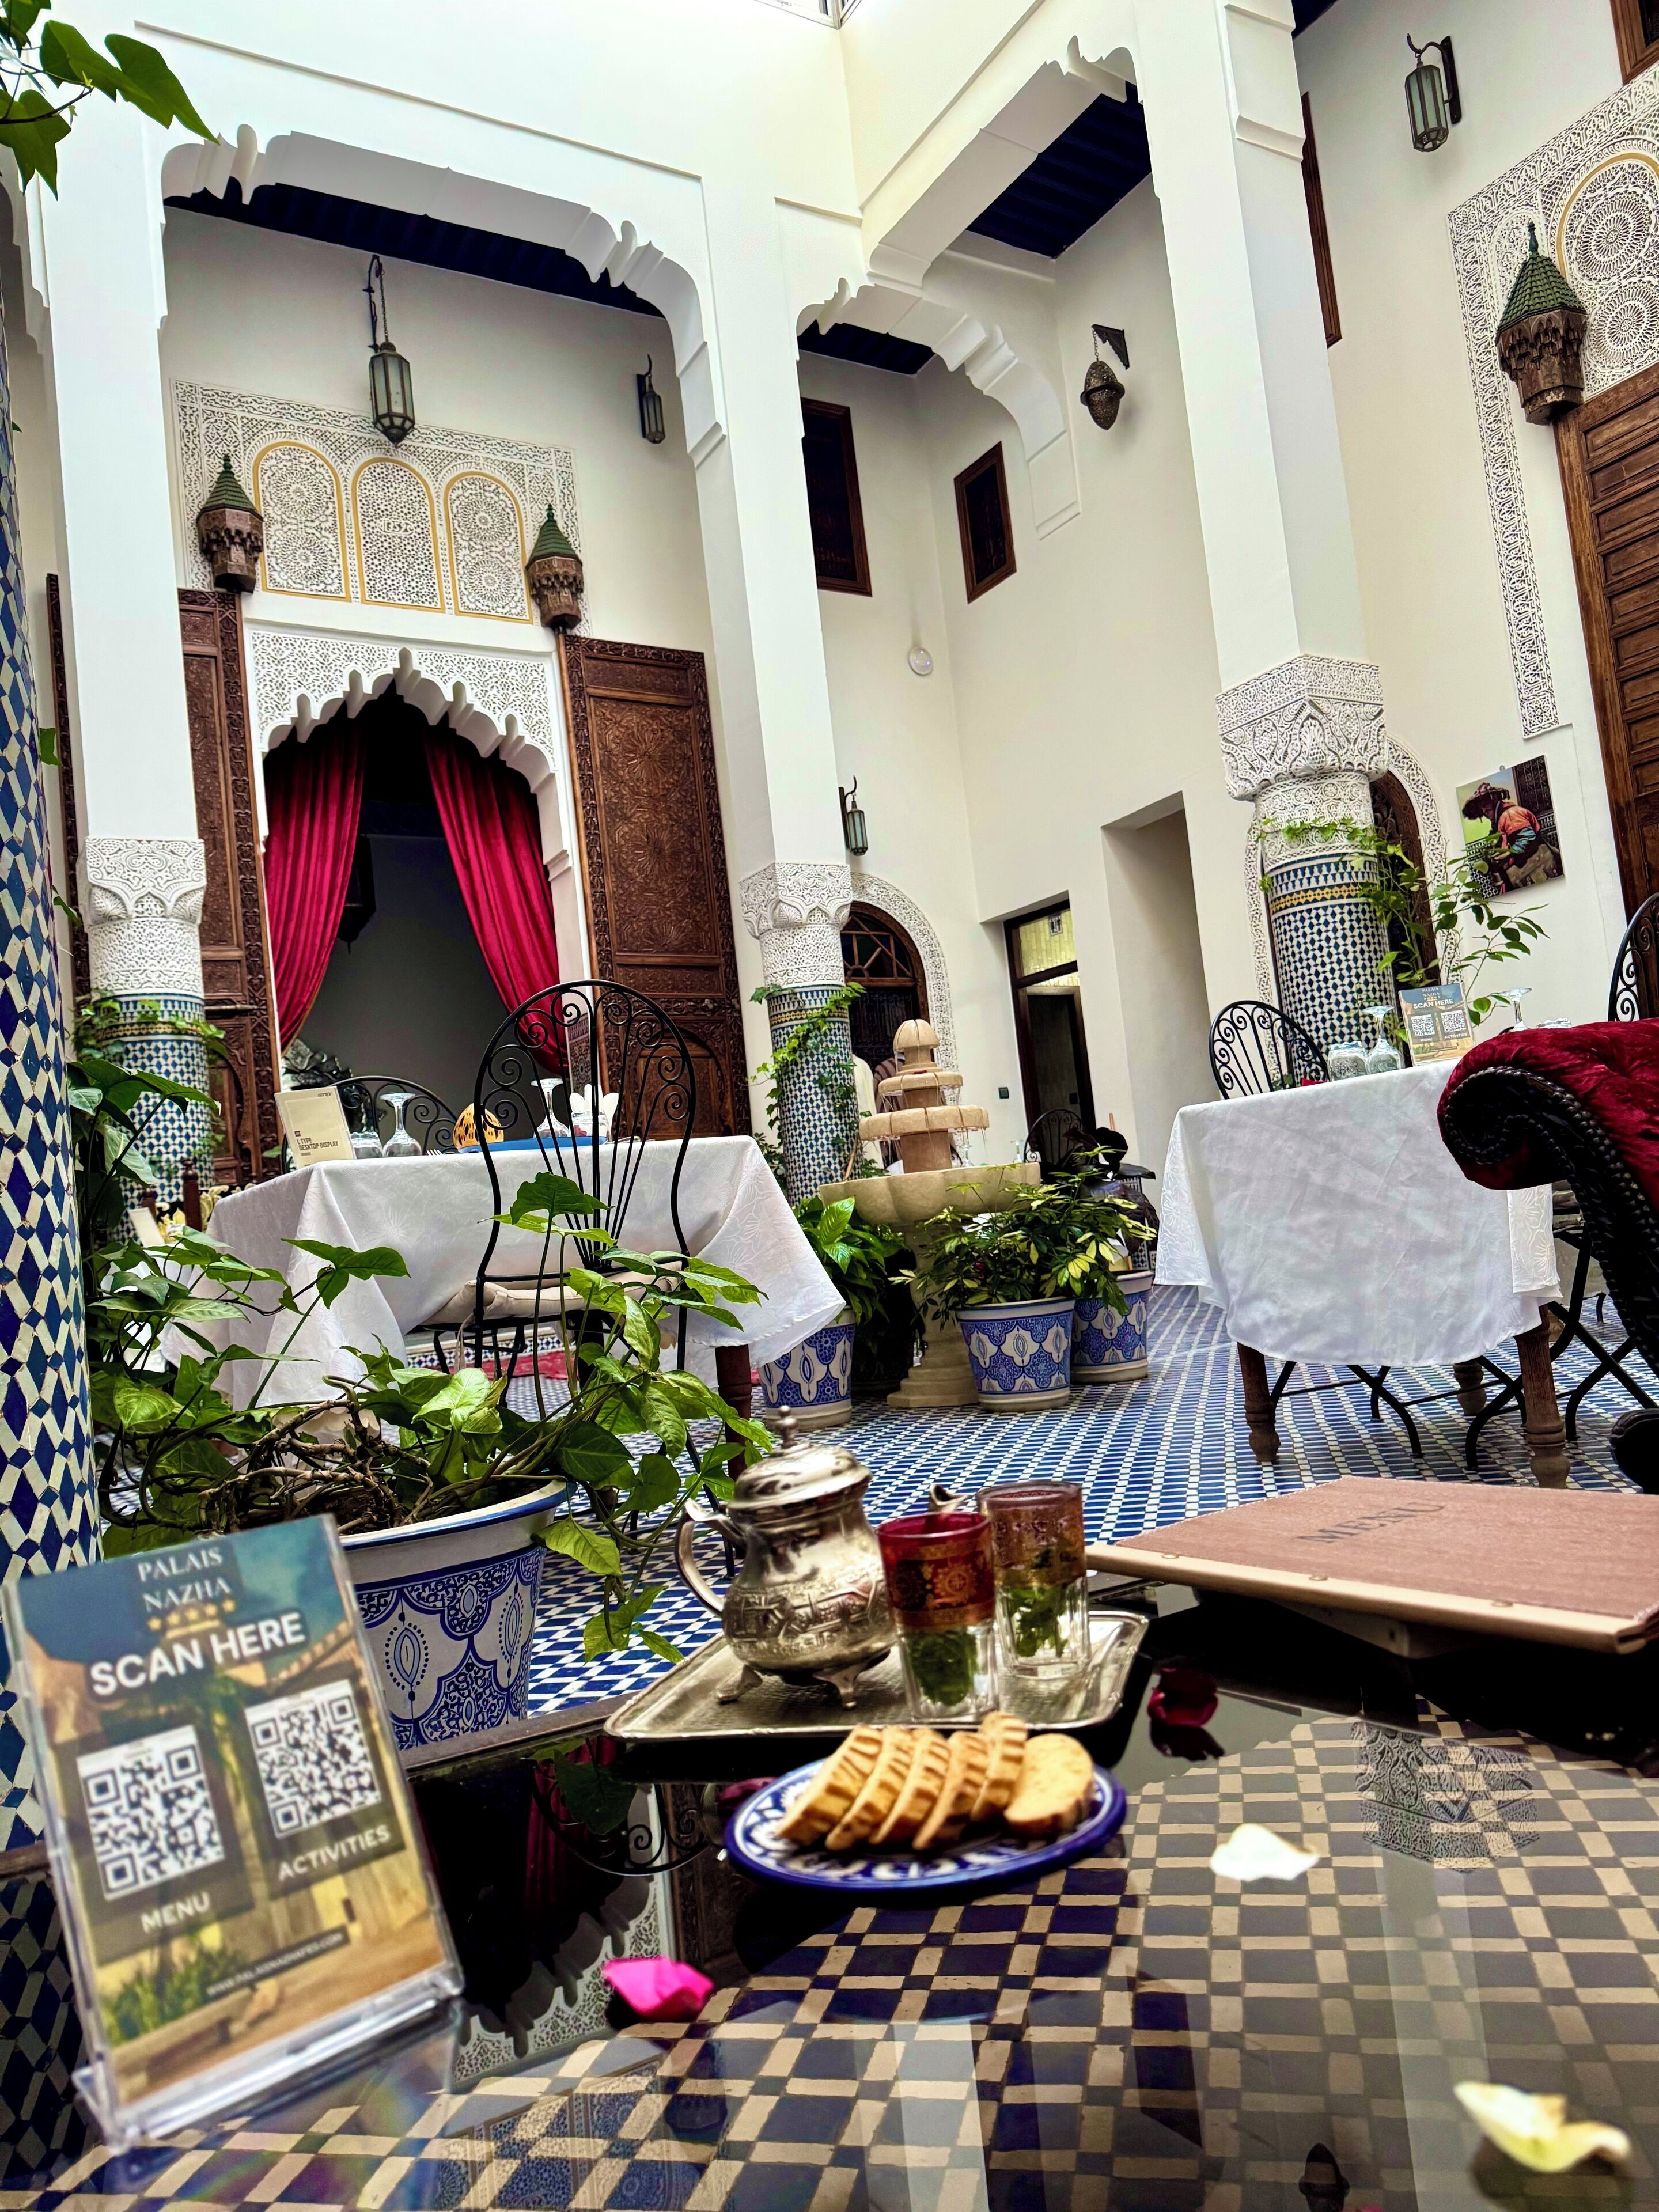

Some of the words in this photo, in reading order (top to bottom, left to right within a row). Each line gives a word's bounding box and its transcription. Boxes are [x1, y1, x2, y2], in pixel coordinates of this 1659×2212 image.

[1413, 1001, 1434, 1009] SCAN
[1435, 998, 1454, 1006] HERE
[298, 1143, 319, 1151] DESKTOP
[319, 1141, 338, 1149] DISPLAY
[1294, 1501, 1444, 1544] MENU
[137, 1546, 224, 1583] PALAIS
[142, 1576, 233, 1612] NAZHA
[90, 1638, 204, 1696] SCAN
[210, 1611, 306, 1665] HERE
[278, 1823, 391, 1881] ACTIVITIES
[140, 1891, 211, 1934] MENU
